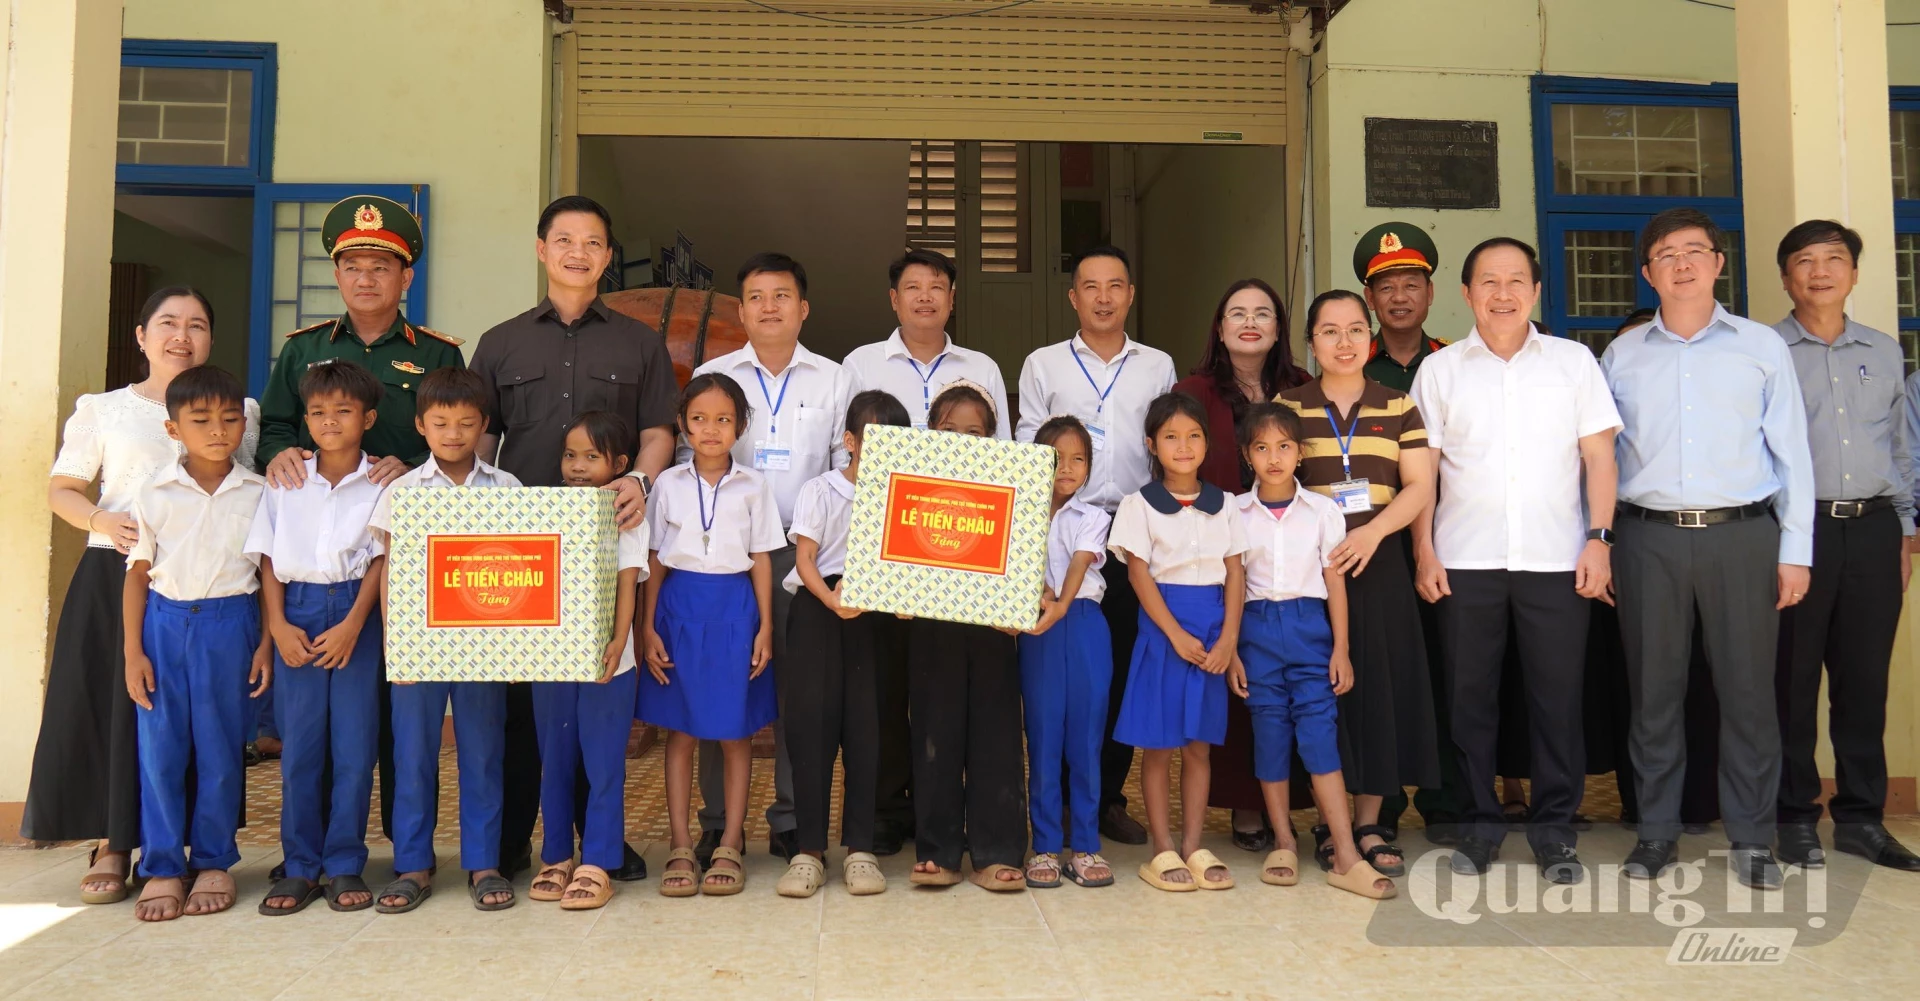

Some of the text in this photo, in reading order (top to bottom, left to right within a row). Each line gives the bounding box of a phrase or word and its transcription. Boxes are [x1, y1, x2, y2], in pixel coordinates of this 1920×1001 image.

[900, 507, 995, 536] LÊ TIẾN CHÂU
[931, 533, 960, 550] Tặng
[444, 566, 544, 588] LÊ TIẾN CHÂU
[478, 592, 510, 606] Tặng
